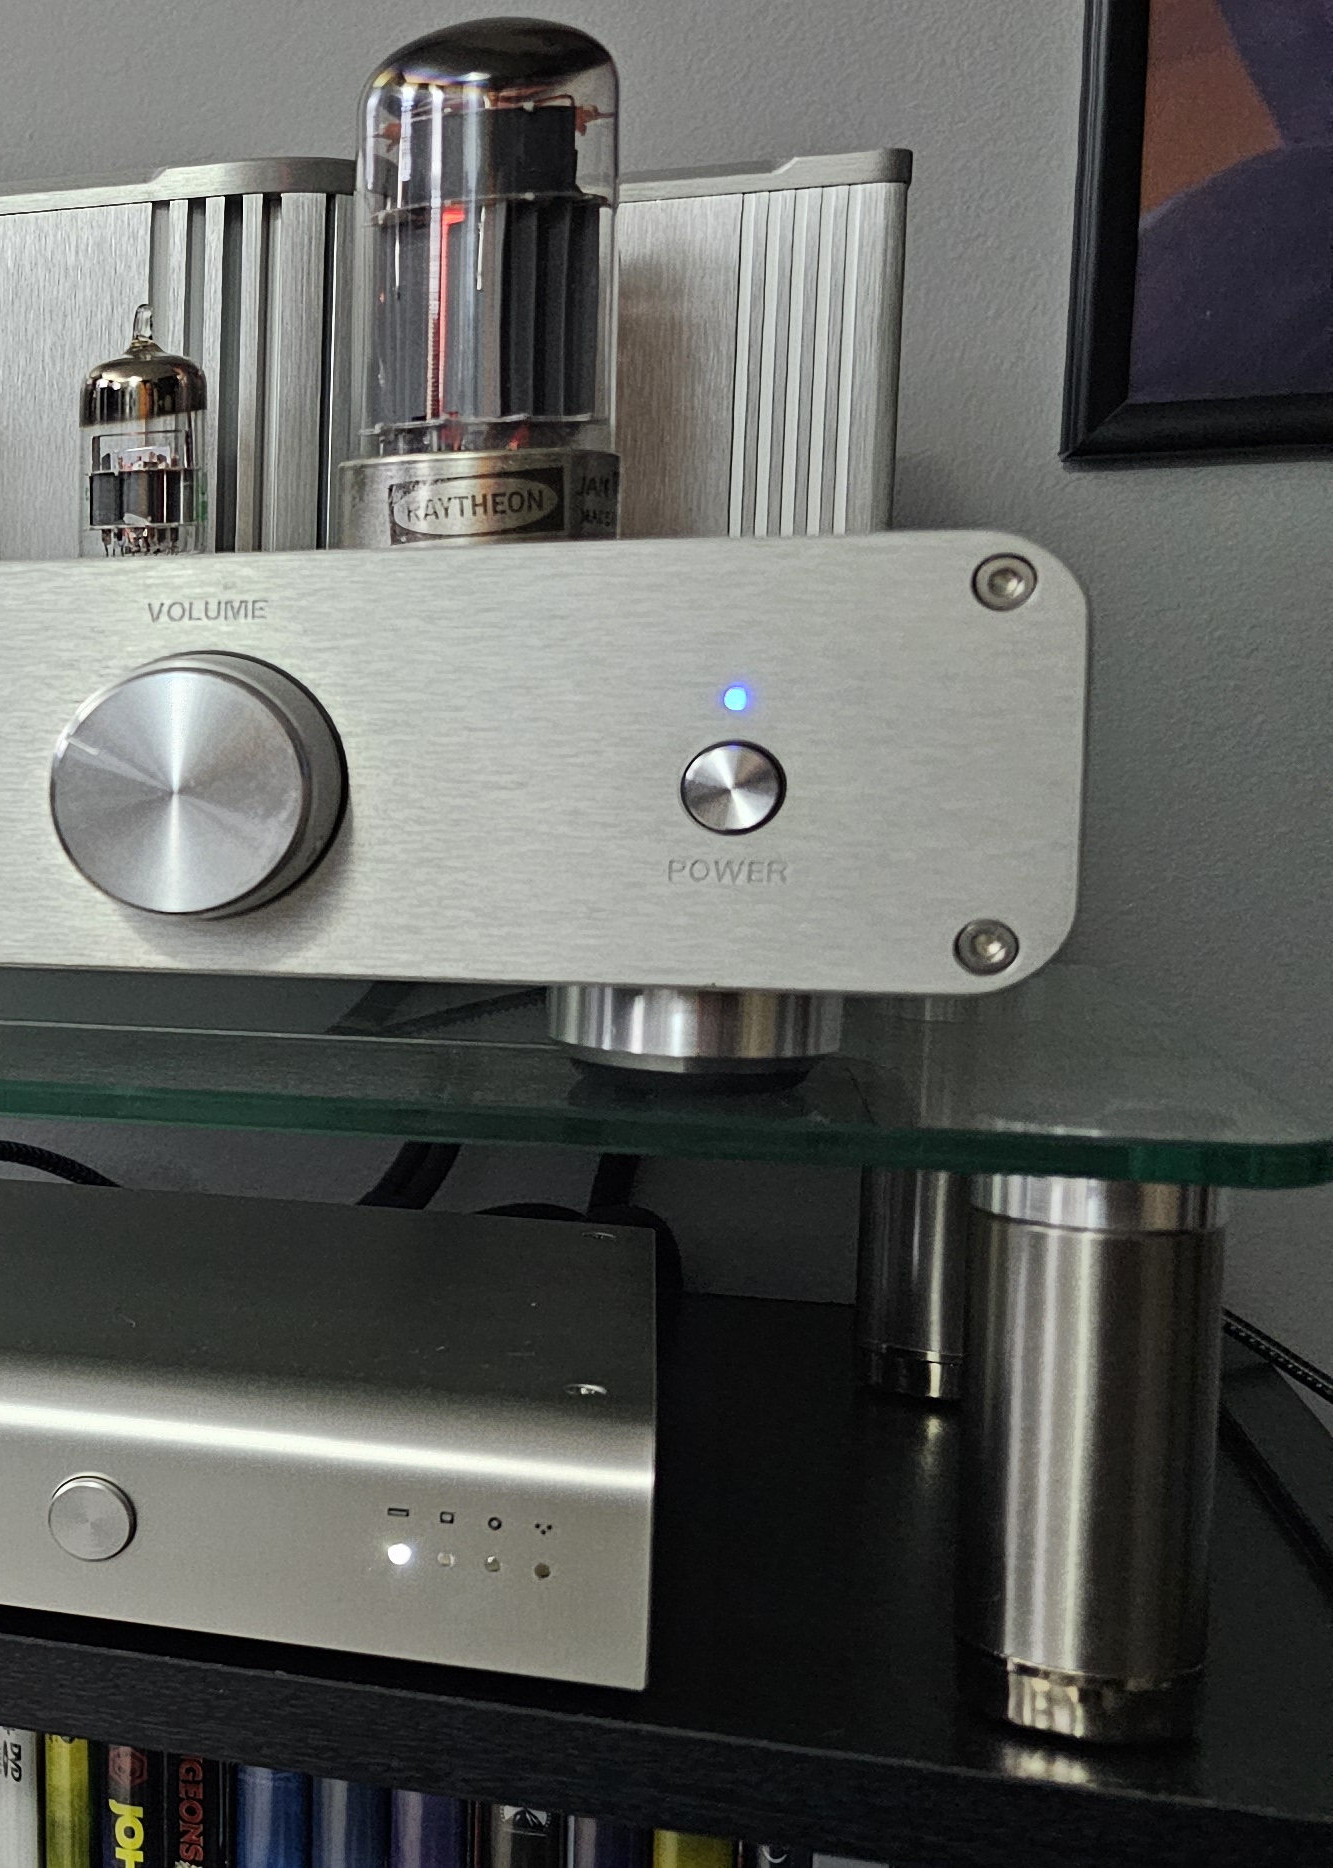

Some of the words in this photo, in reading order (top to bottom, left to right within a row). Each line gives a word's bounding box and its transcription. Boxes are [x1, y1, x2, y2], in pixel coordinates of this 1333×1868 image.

[406, 488, 545, 523] RAYTHEON
[146, 599, 270, 625] VOLUME
[667, 858, 790, 886] POWER
[10, 1741, 23, 1783] DVD
[177, 1756, 205, 1862] GEONS
